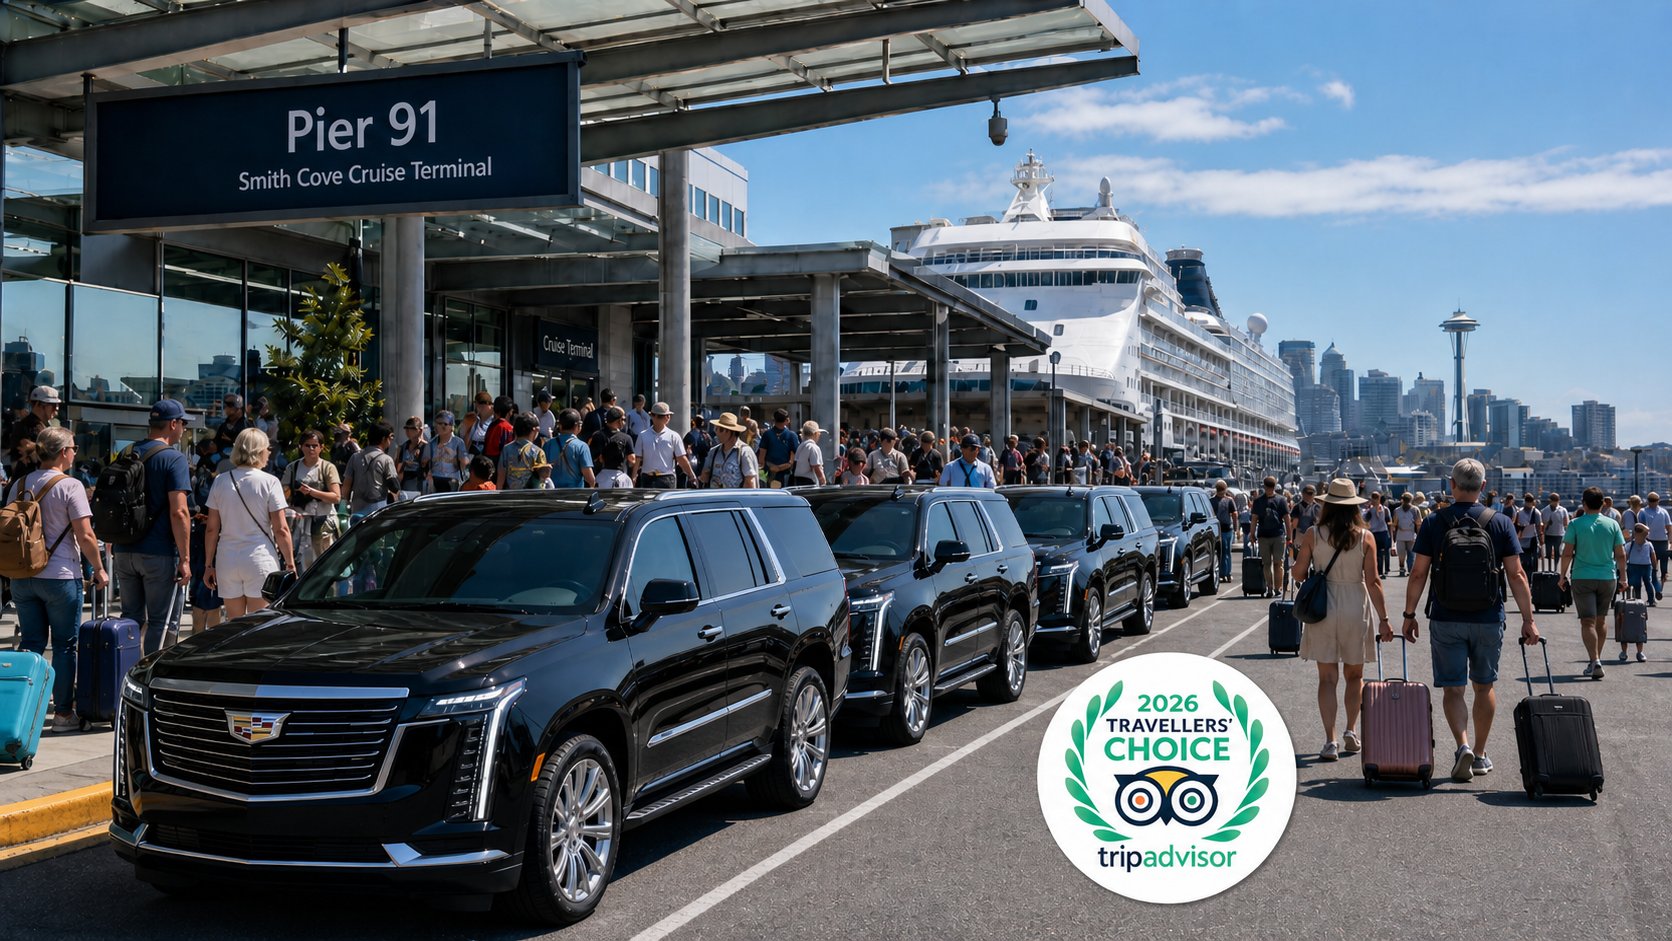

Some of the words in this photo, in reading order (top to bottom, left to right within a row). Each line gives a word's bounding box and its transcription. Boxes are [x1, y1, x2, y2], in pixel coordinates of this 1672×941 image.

[288, 106, 373, 153] Pier
[388, 100, 436, 147] 91
[238, 168, 291, 191] Smith
[297, 167, 344, 187] Cove
[349, 162, 406, 184] Cruise
[410, 155, 492, 180] Terminal
[543, 335, 565, 354] Cruise
[566, 339, 594, 359] Terminal
